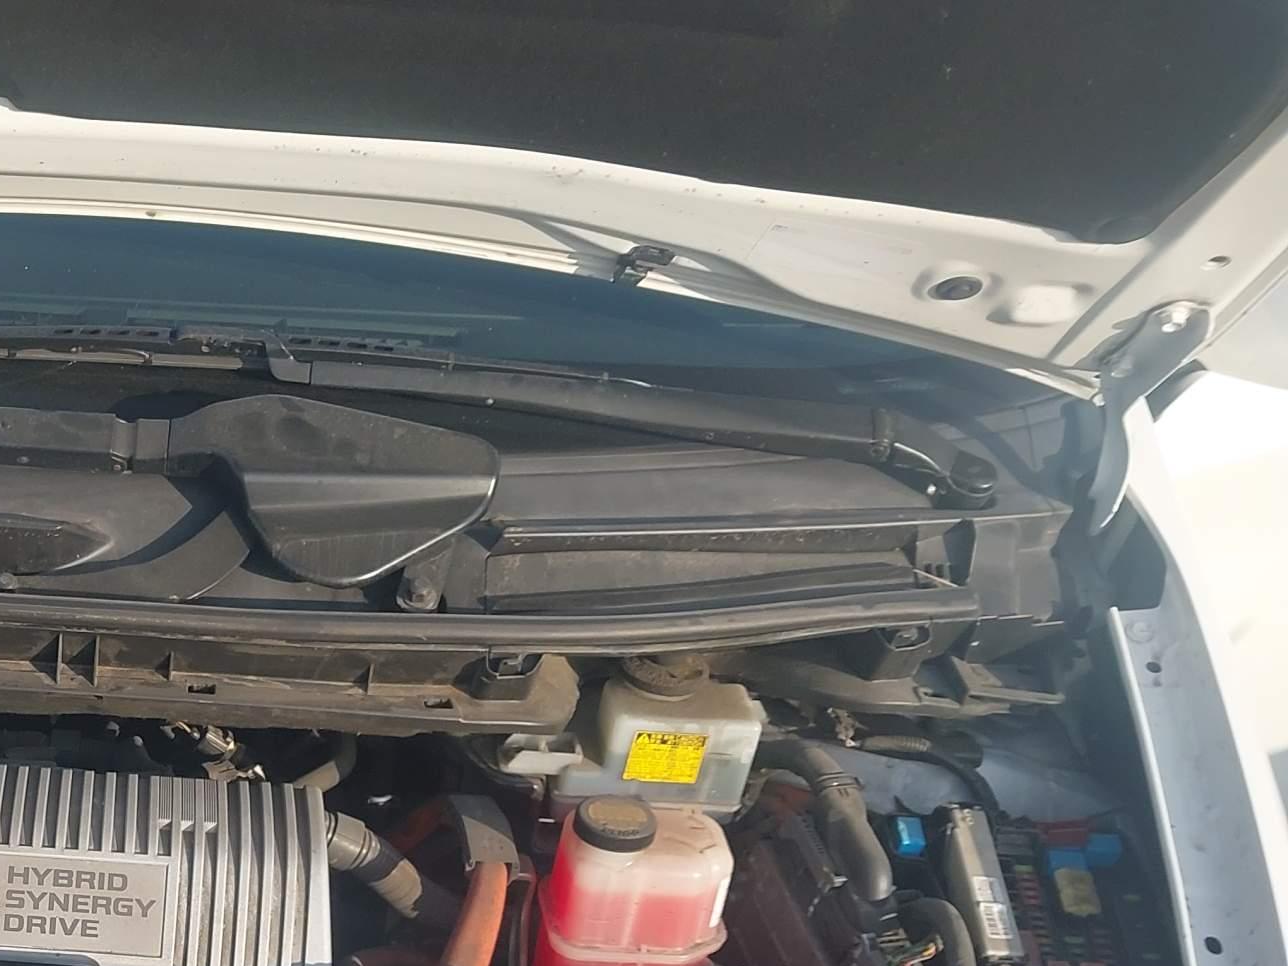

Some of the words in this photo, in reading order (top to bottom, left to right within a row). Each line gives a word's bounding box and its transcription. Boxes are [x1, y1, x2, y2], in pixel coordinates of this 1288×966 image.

[7, 865, 128, 892] HYBRID
[4, 889, 157, 918] SYNERGY
[3, 913, 100, 938] DRIVE
